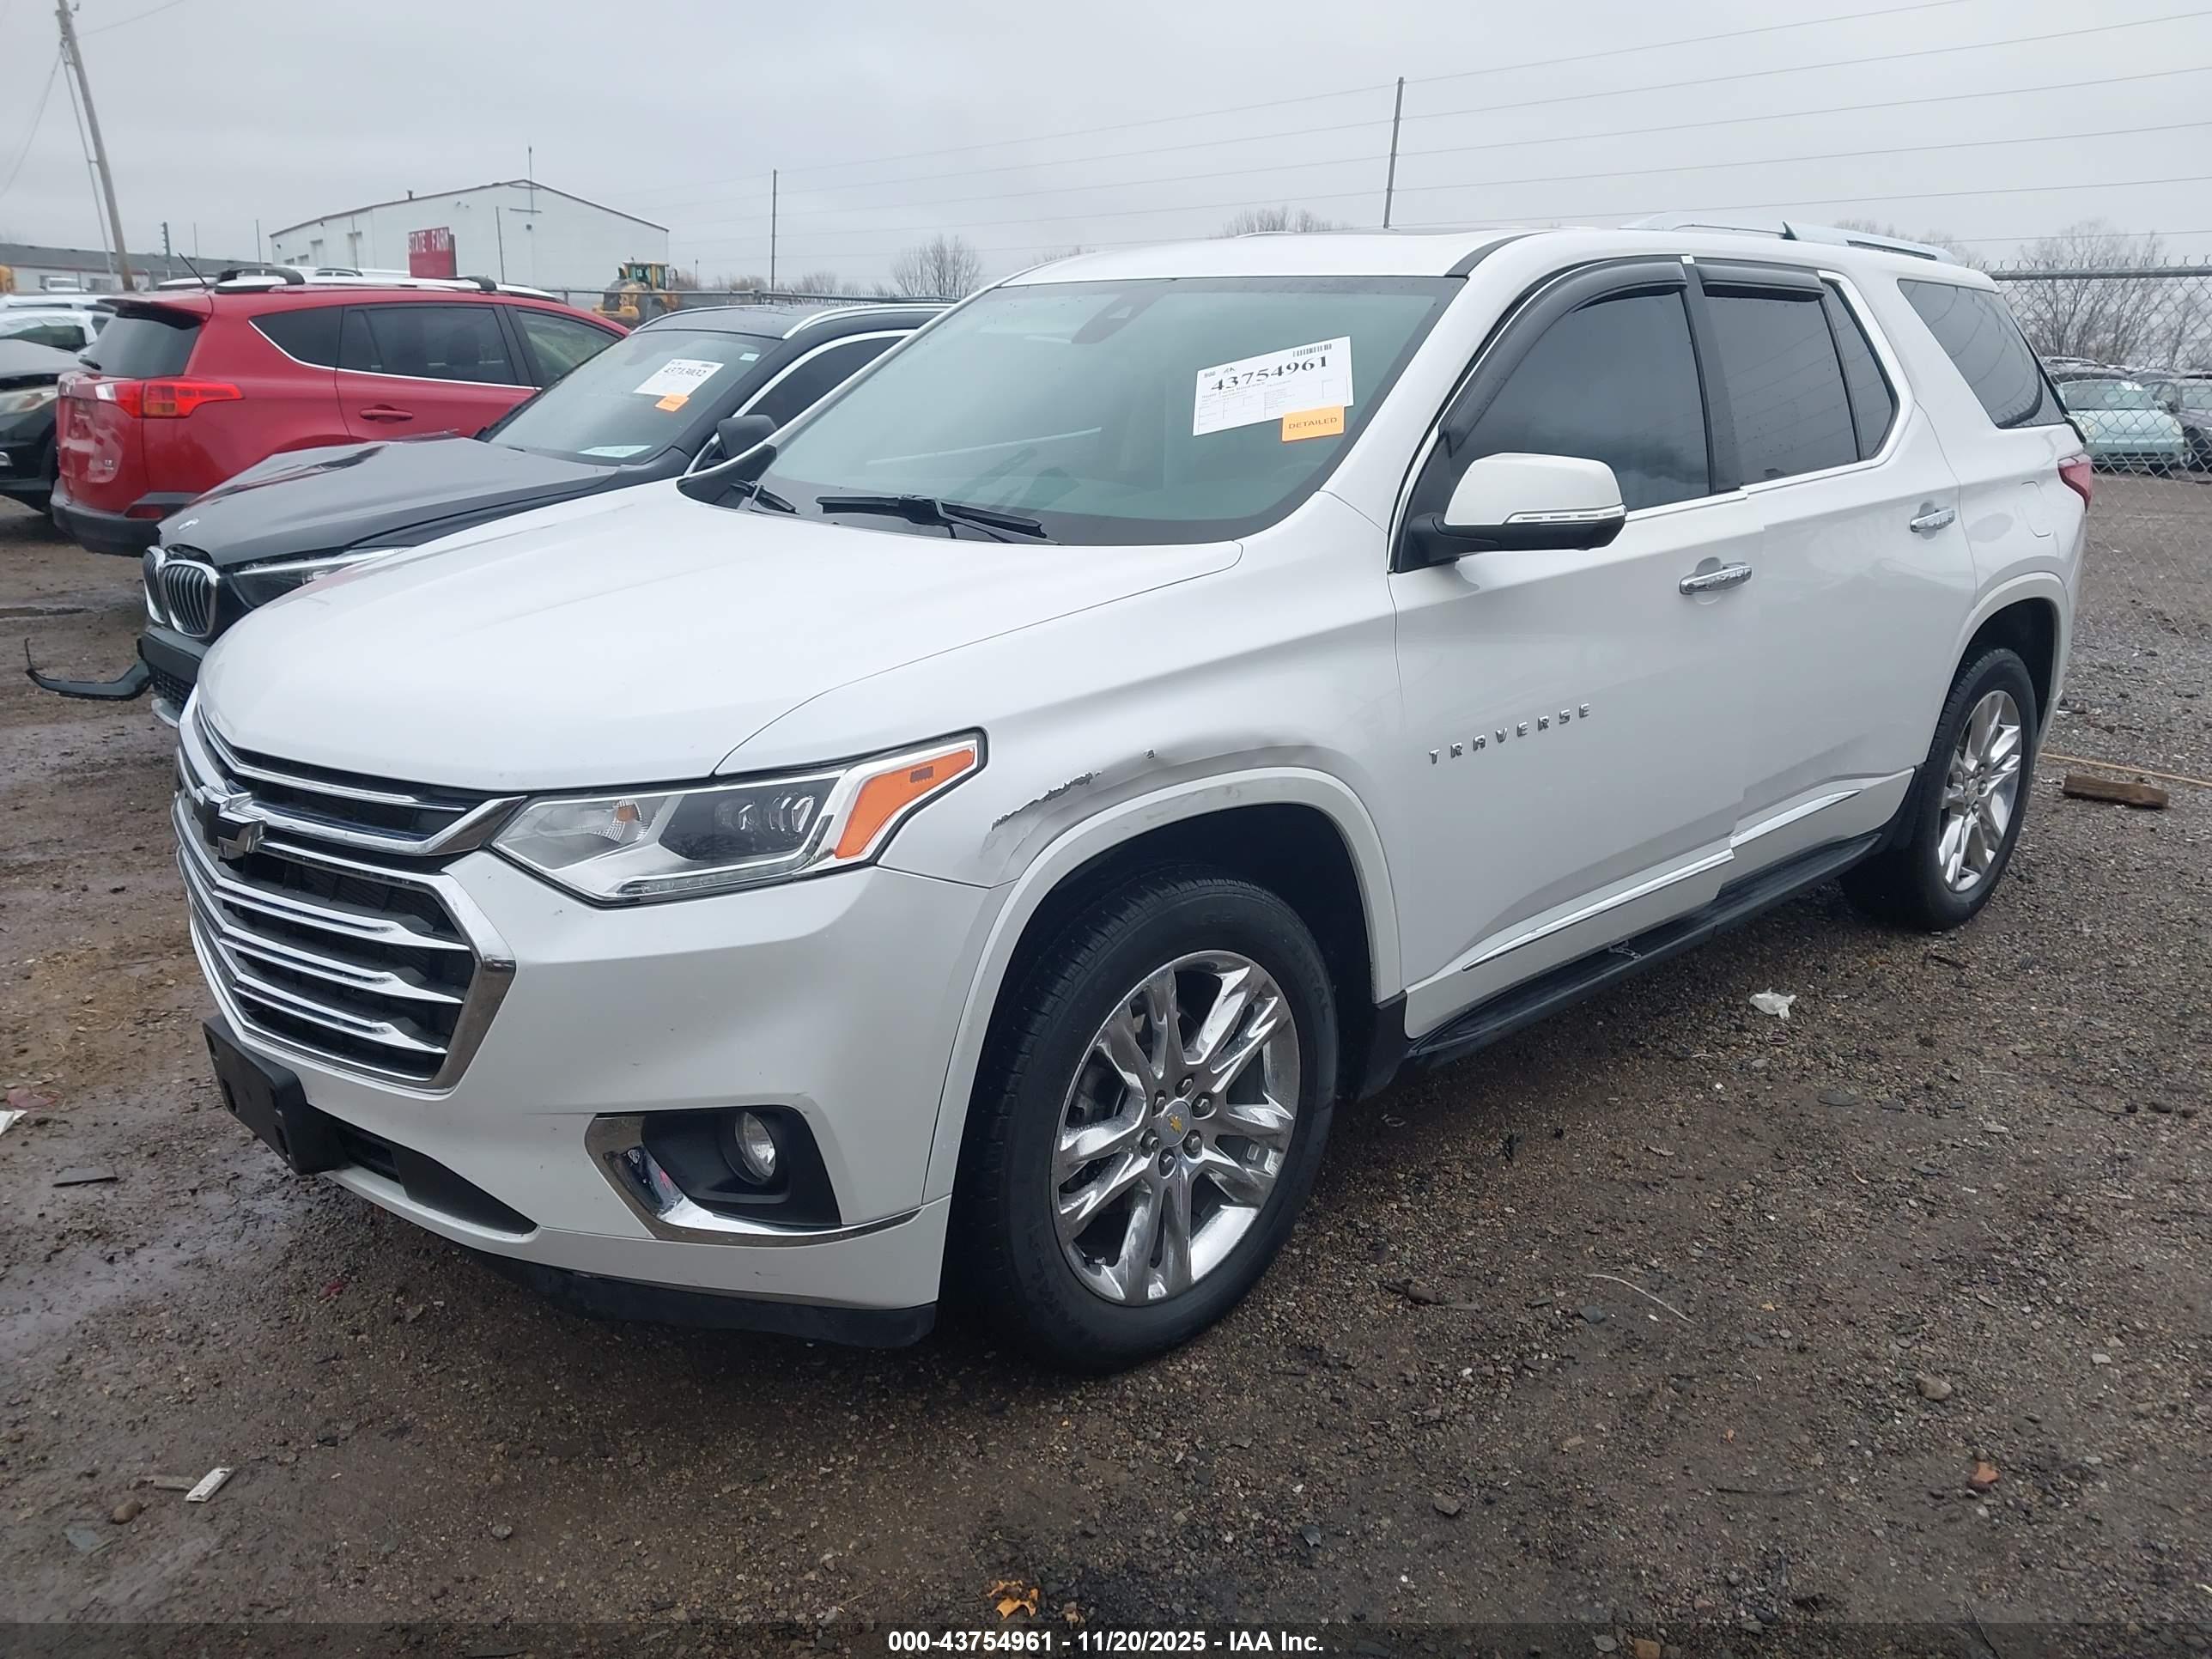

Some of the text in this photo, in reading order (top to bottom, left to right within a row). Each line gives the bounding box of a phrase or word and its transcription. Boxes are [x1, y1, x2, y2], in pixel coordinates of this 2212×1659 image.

[409, 232, 427, 254] STATE
[1211, 356, 1328, 392] 43754961
[1288, 416, 1338, 430] DETAILED
[1429, 703, 1590, 764] TRAVERSE
